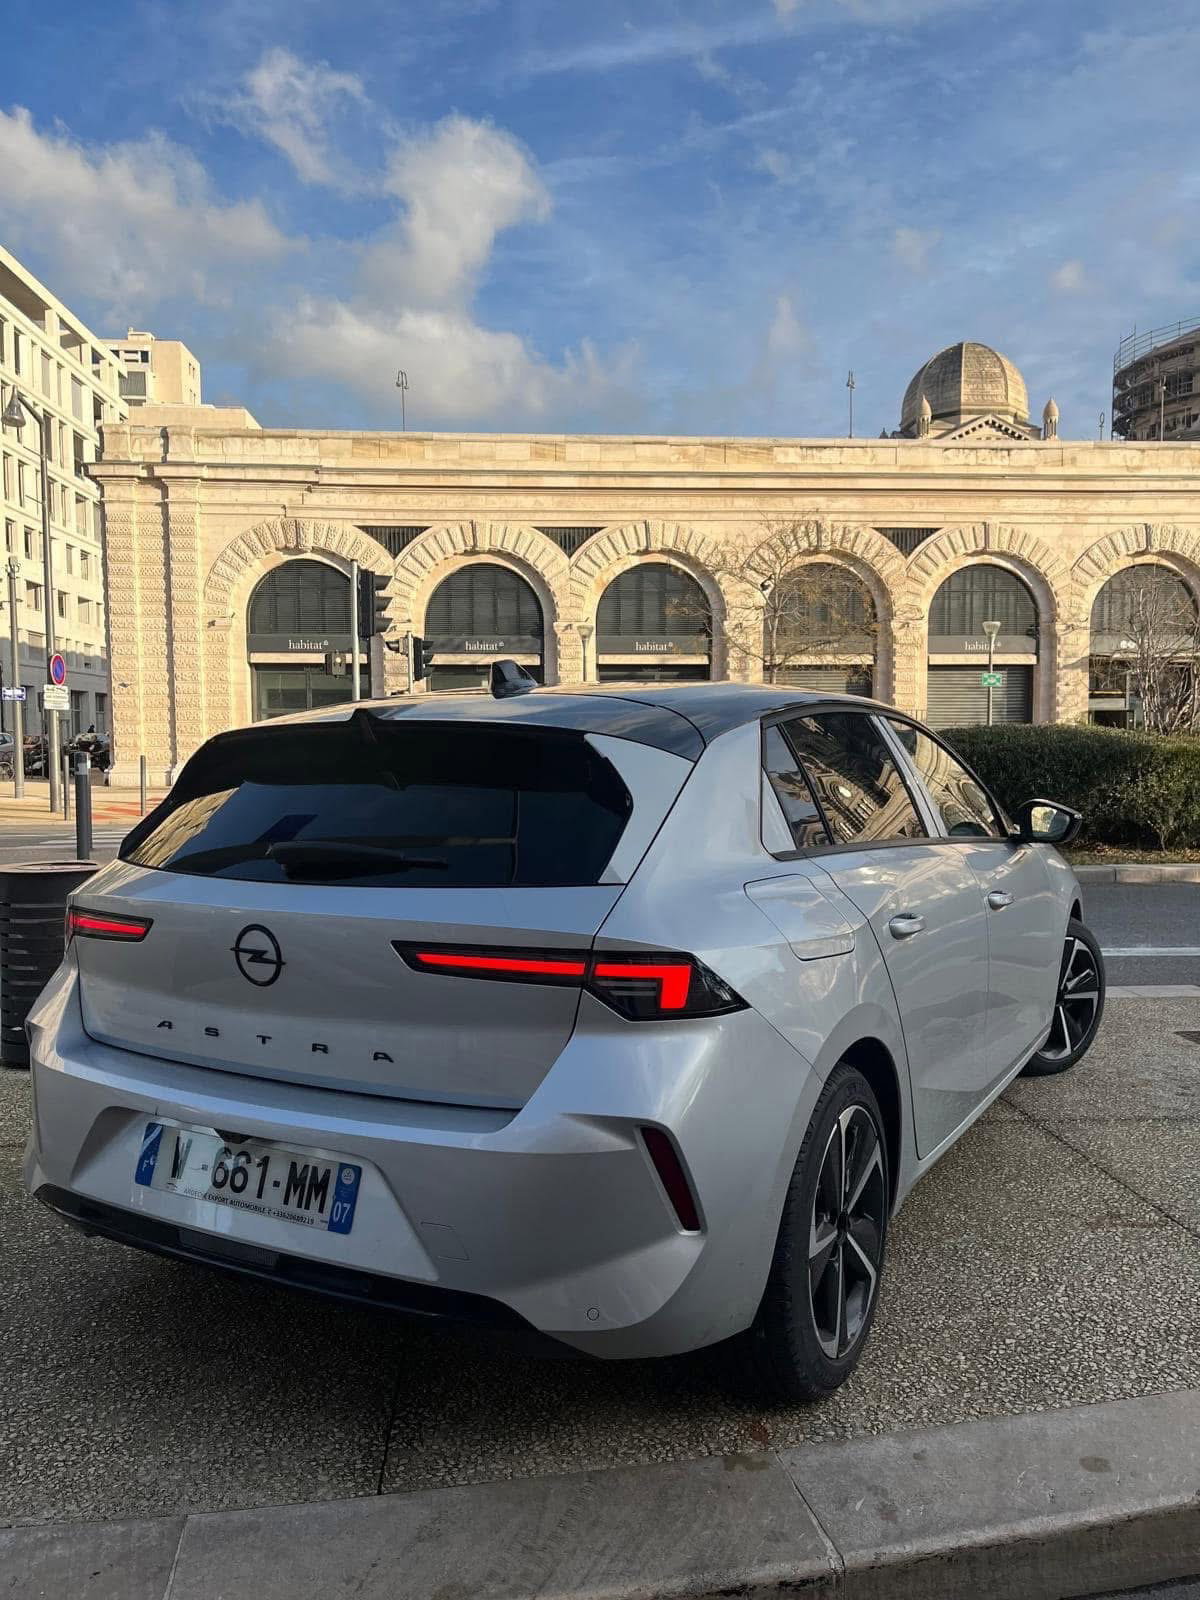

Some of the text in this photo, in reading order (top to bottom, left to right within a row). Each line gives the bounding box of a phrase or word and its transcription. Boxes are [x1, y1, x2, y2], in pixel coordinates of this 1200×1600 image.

[288, 639, 322, 650] habitat
[465, 640, 498, 651] habitat
[635, 641, 667, 651] habitat
[157, 1020, 394, 1064] ASTRA
[229, 1199, 266, 1216] AUTOMOBILE
[332, 1200, 351, 1224] 07
